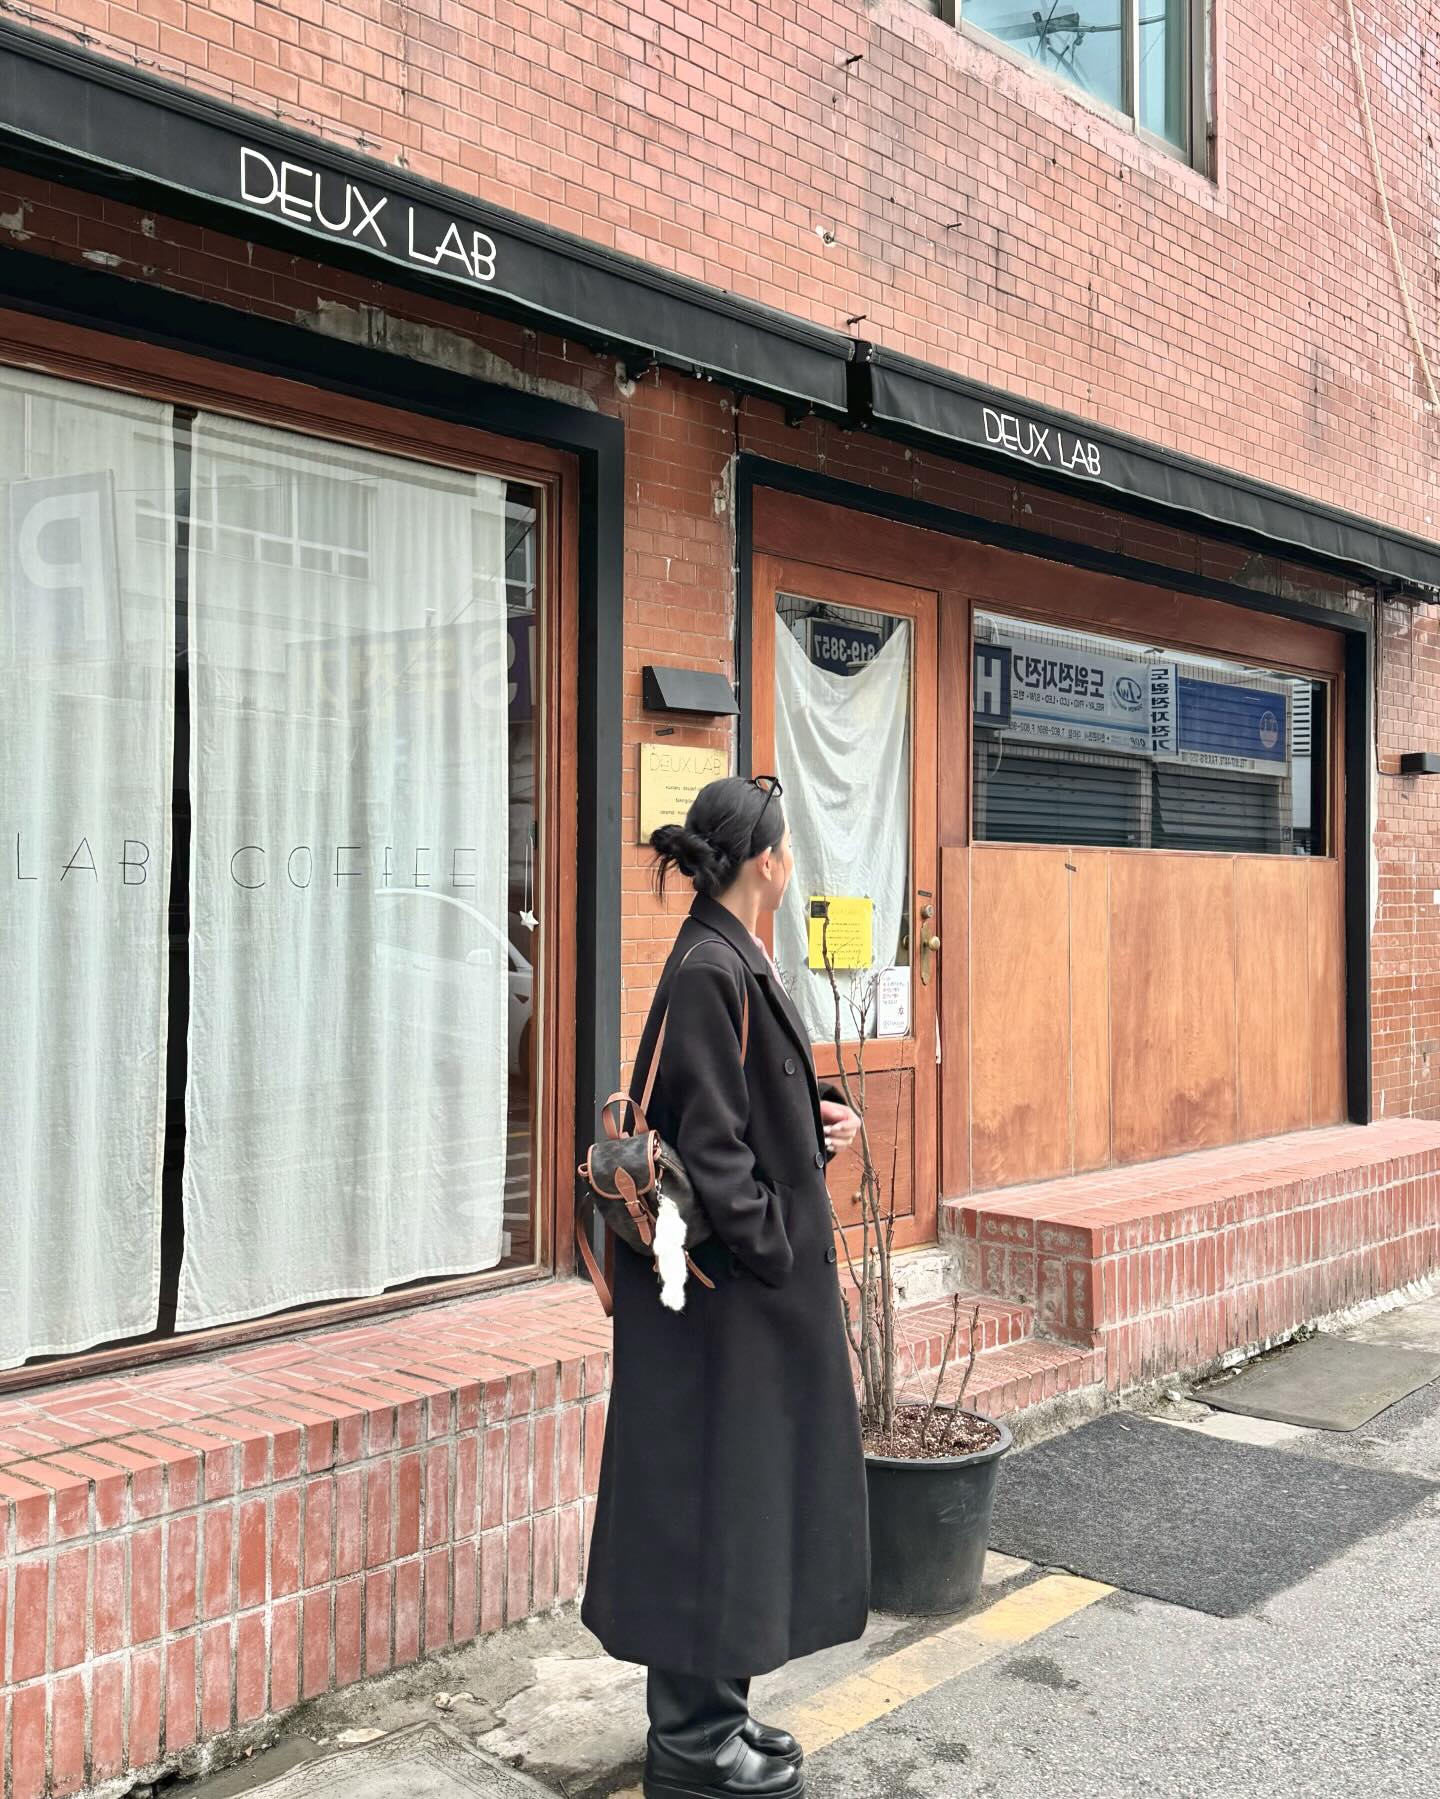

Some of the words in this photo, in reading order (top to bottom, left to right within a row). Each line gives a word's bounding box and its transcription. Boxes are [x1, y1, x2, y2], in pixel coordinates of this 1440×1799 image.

[240, 146, 388, 247] DEUX
[408, 206, 497, 281] LAB
[983, 407, 1051, 461] DEUX
[1058, 433, 1101, 475] LAB
[649, 752, 691, 773] DEUX
[694, 756, 722, 776] LAB
[17, 832, 151, 886] LAB
[230, 845, 477, 889] COFFEE
